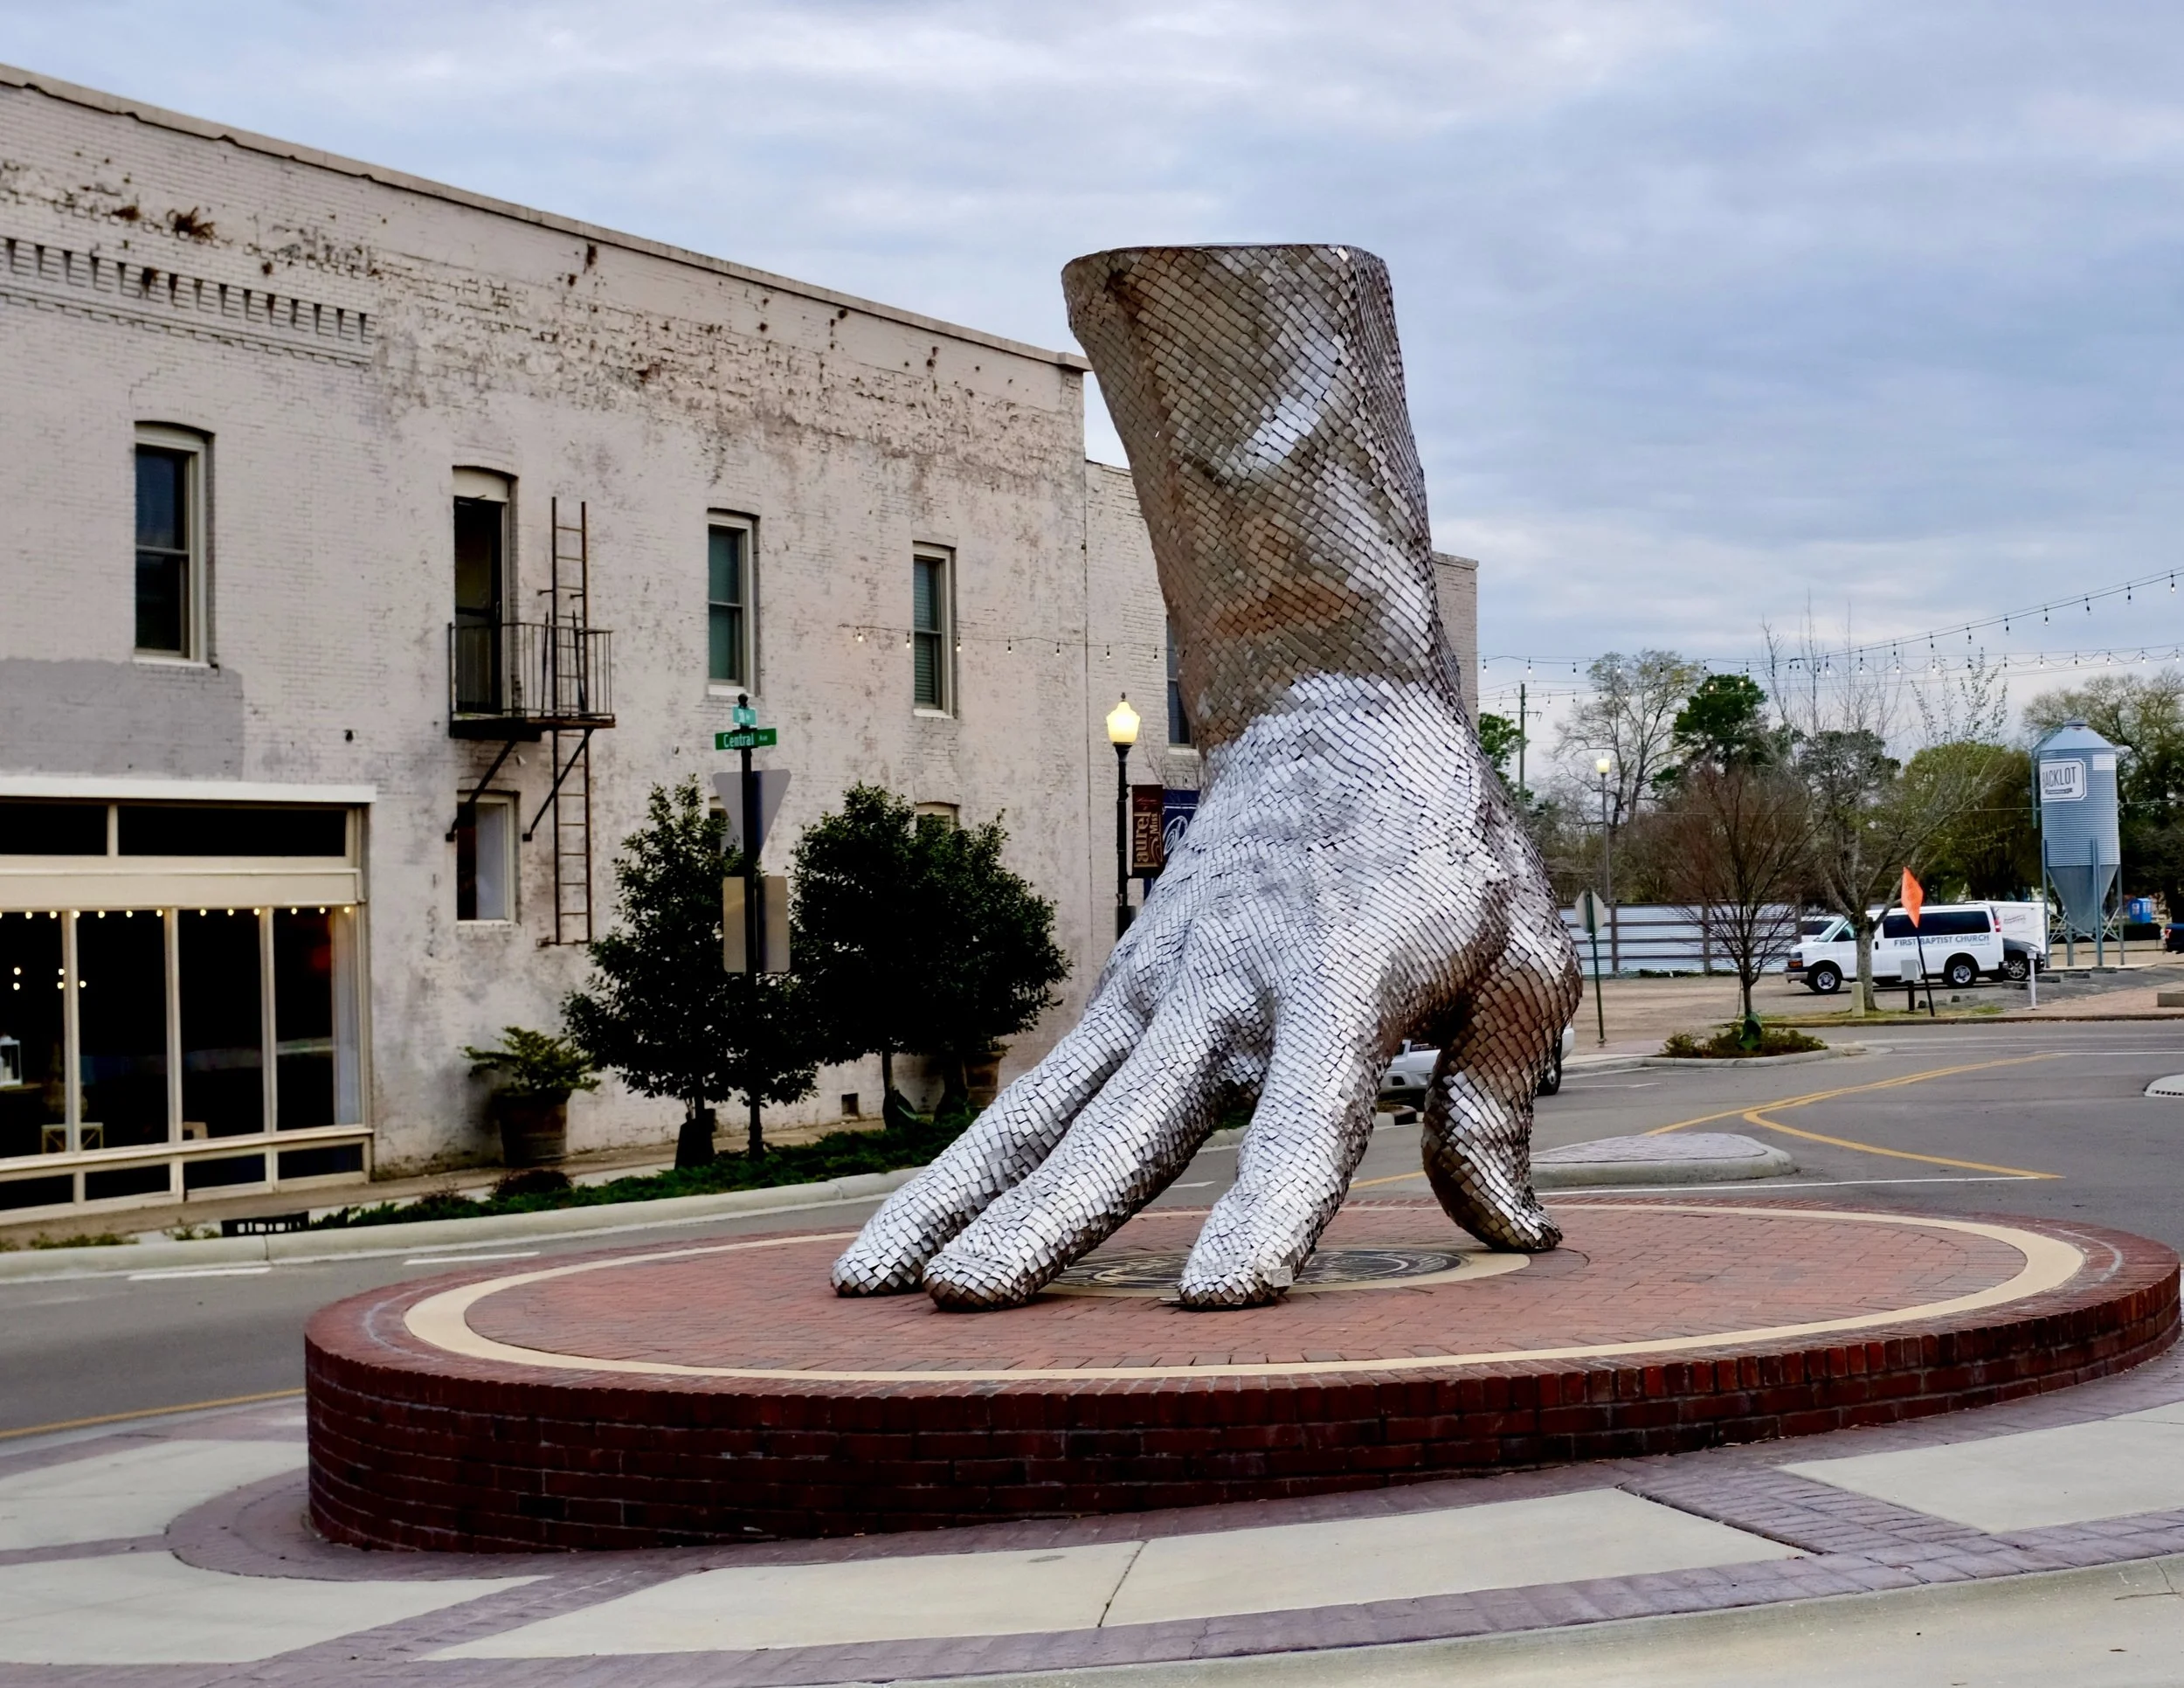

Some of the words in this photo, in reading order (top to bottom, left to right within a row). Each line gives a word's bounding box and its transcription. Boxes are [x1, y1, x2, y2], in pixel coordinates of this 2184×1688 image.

[723, 732, 754, 748] Central
[1134, 812, 1159, 868] Laurel
[1894, 937, 1917, 946] FIRST
[1919, 936, 1952, 944] BAPTIST
[1955, 934, 1989, 943] CHURCH
